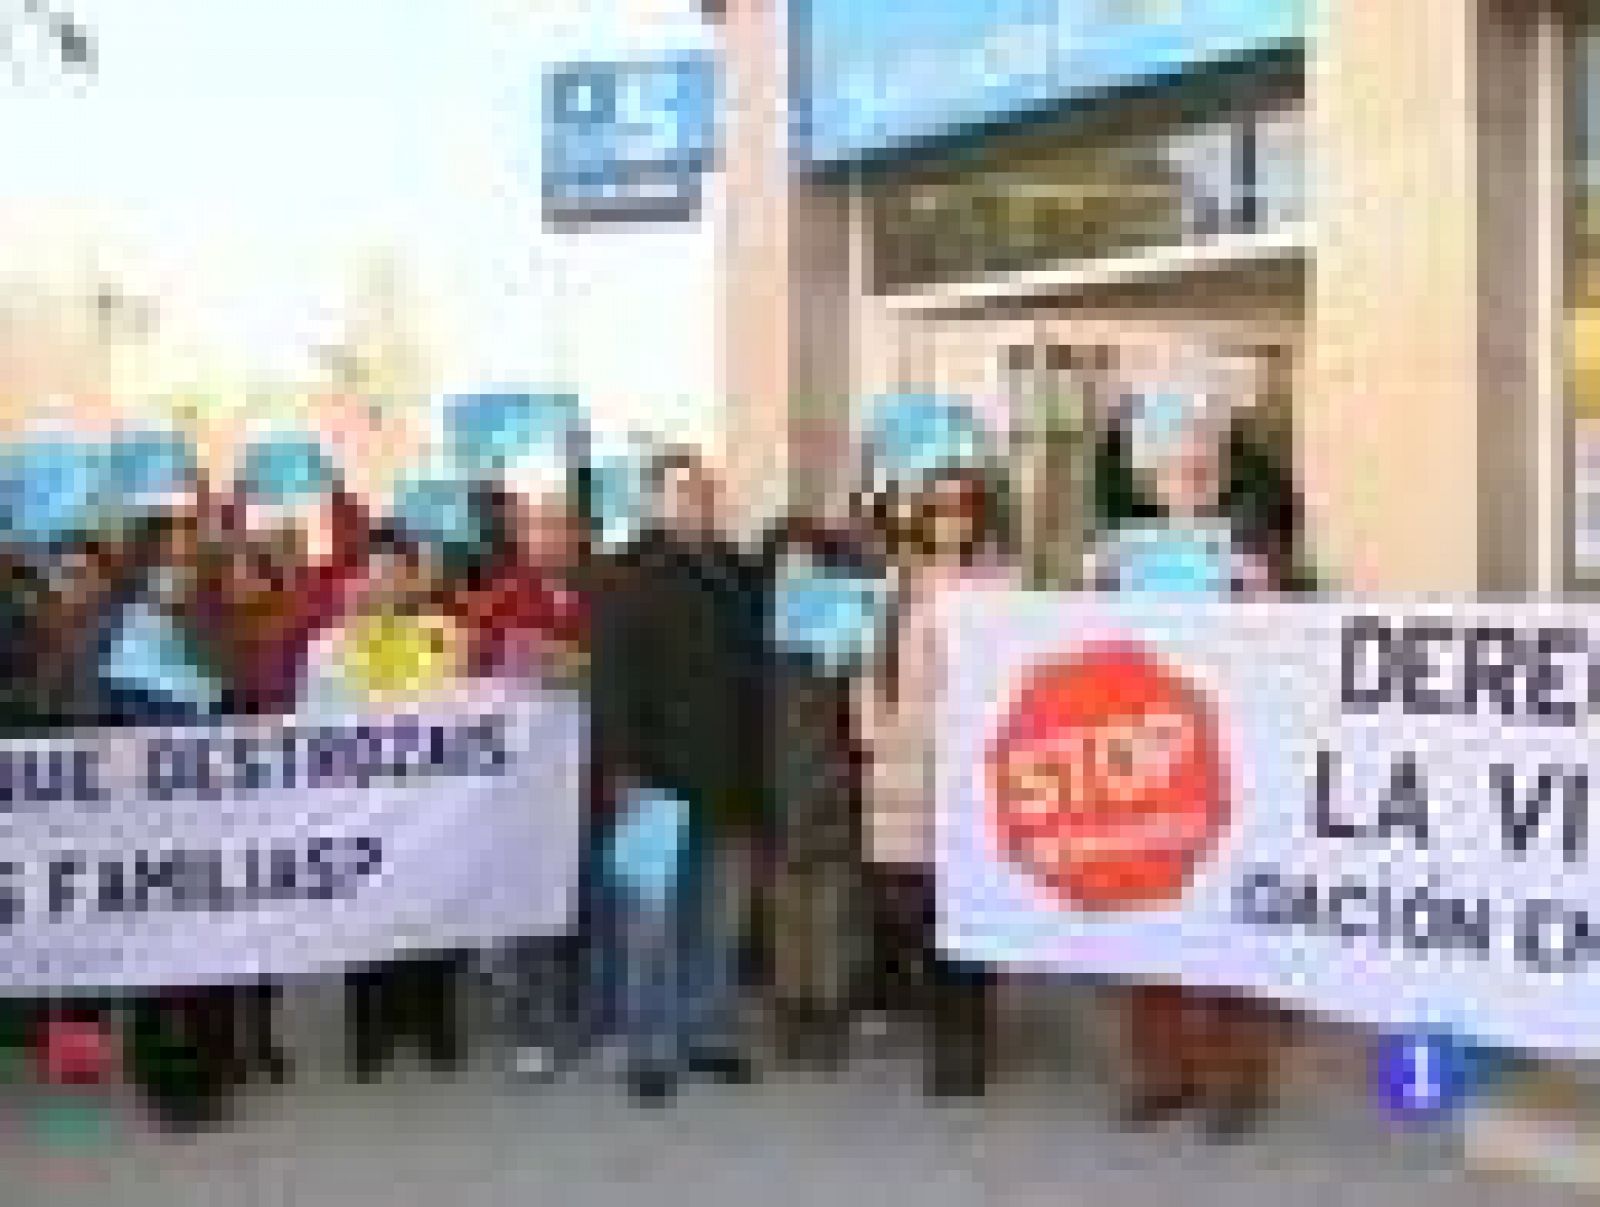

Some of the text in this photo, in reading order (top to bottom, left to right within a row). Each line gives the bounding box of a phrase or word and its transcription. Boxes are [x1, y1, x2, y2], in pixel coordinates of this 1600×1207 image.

[146, 715, 507, 800] DESTROZAIS
[1006, 708, 1192, 820] STOP
[1314, 748, 1429, 848] LA
[49, 836, 384, 922] FAMILIAS?
